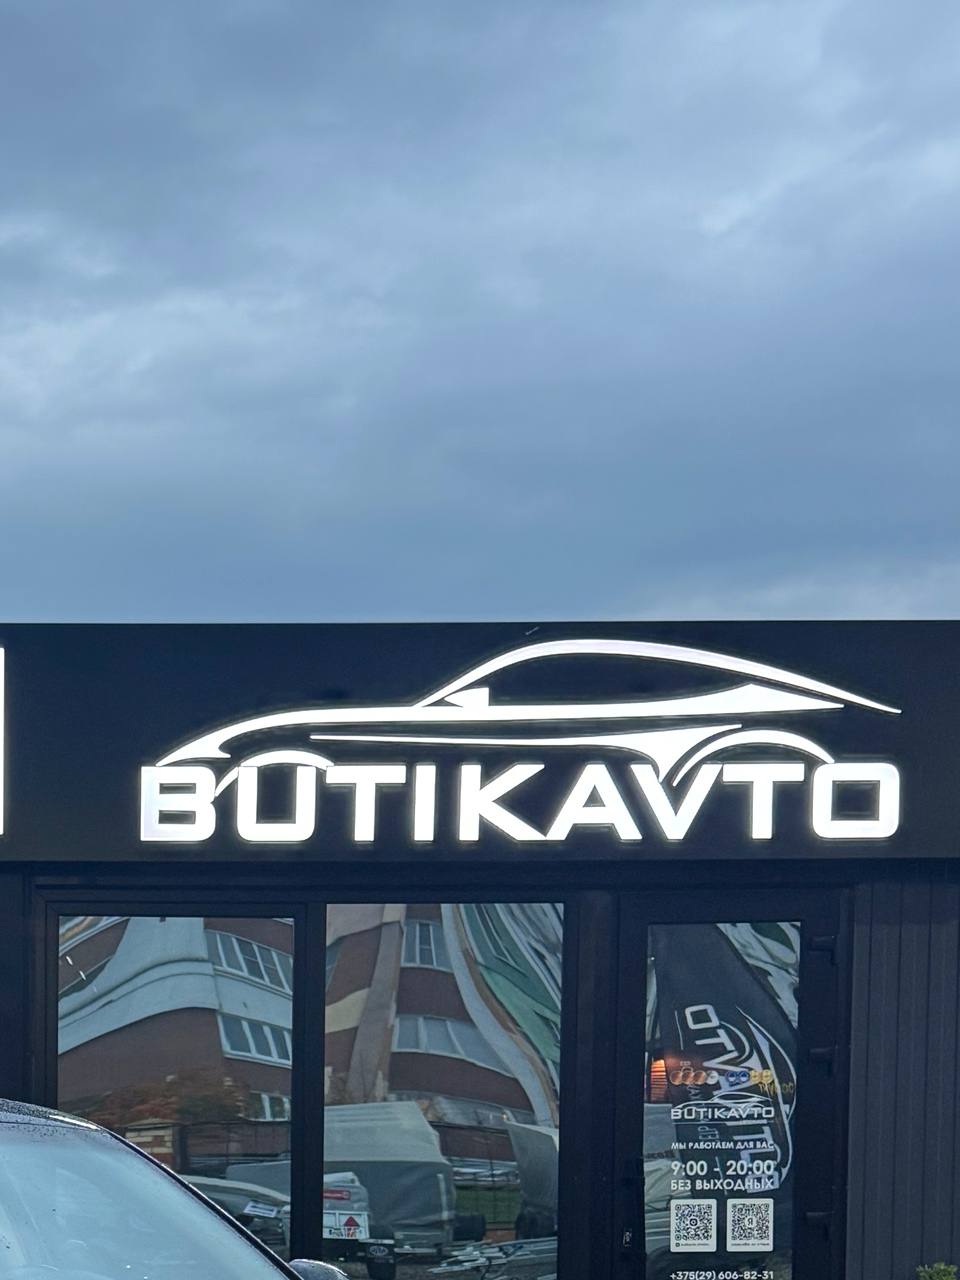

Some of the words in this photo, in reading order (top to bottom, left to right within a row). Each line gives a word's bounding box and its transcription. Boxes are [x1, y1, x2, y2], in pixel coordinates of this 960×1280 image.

[140, 761, 901, 843] BUTIKAVTO
[670, 1106, 775, 1119] BUTIKAVTO
[688, 1141, 734, 1149] РАБОТАЕМ
[736, 1142, 753, 1150] ДЛЯ
[671, 1160, 708, 1176] 9:00
[725, 1160, 775, 1176] 20:00
[670, 1179, 691, 1190] БЕЗ
[695, 1179, 774, 1191] ВЫХОДНЫХ
[718, 1270, 774, 1280] 606-82-31
